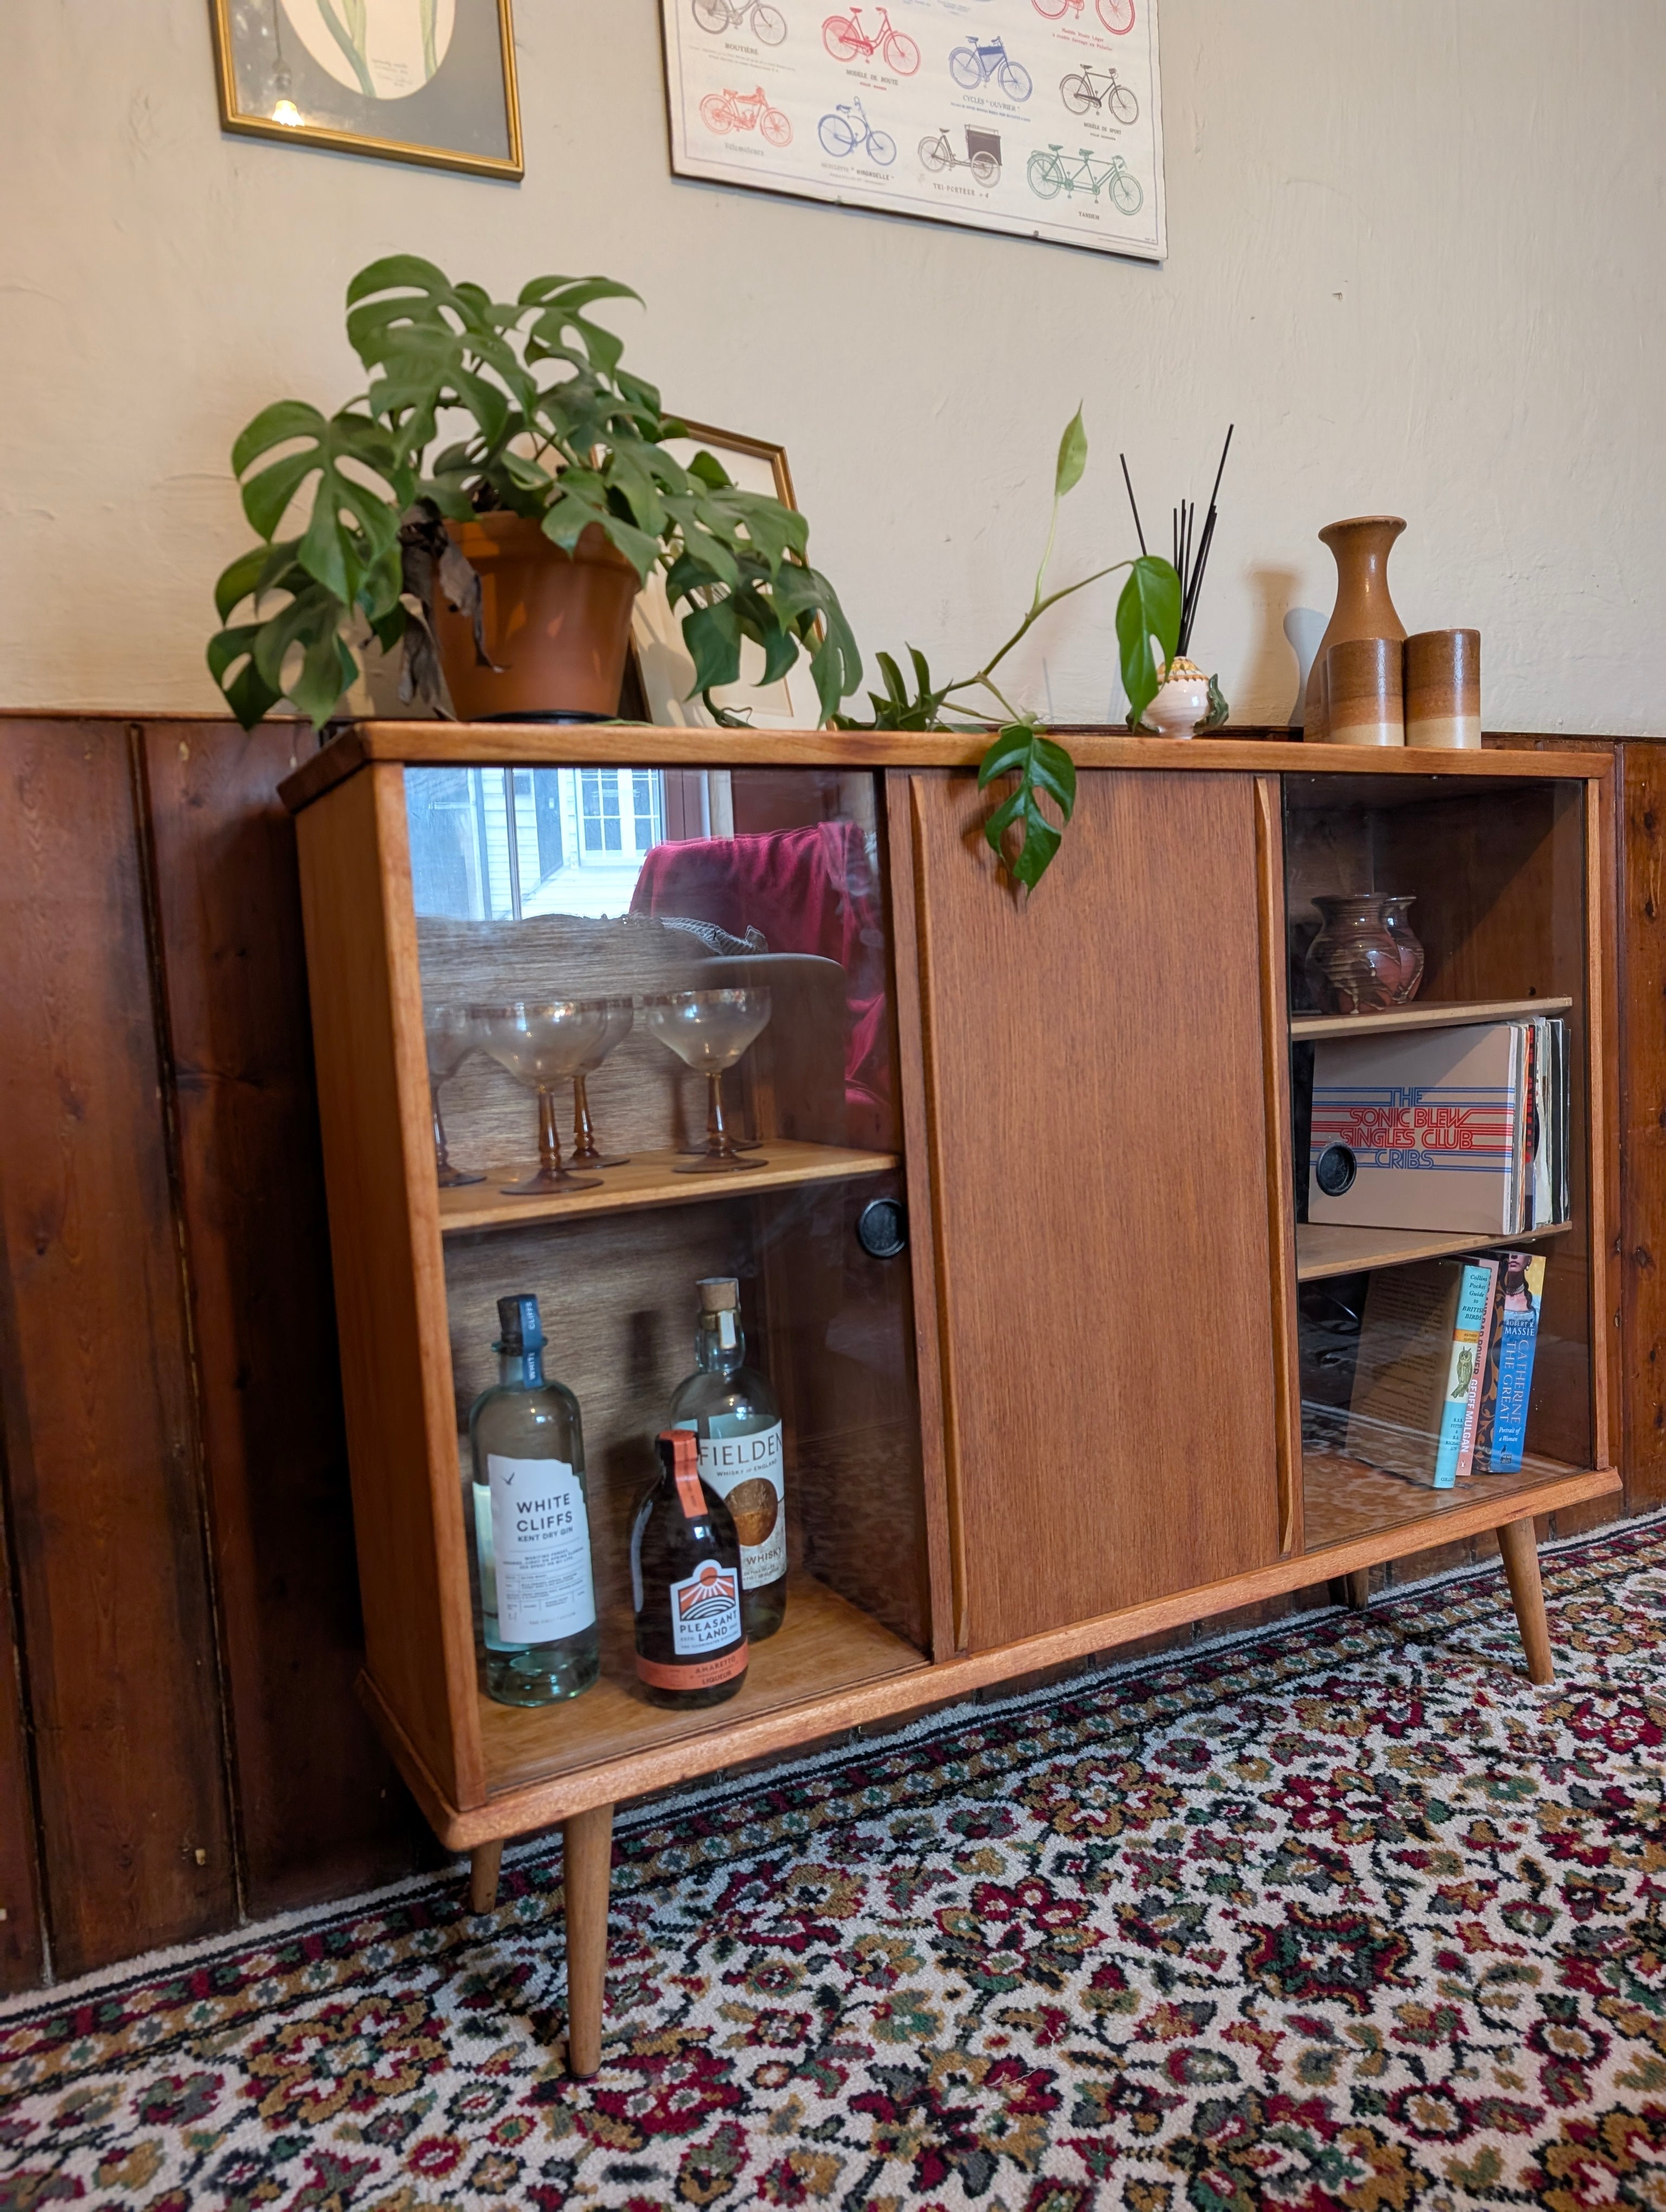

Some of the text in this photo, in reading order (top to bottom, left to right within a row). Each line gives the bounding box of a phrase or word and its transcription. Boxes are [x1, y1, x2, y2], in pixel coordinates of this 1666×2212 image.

[725, 43, 759, 54] ROUTIÈRE
[963, 95, 985, 105] CYCLES
[933, 183, 975, 196] TRI-PORTEUR
[1078, 211, 1100, 220] TANDEM
[1390, 1087, 1422, 1107] THE
[1350, 1108, 1465, 1129] SONIC BLEW
[1340, 1127, 1473, 1149] SINGLES CLUB
[1375, 1149, 1434, 1169] CRIBS
[525, 1301, 536, 1330] CLIFFS
[1504, 1327, 1535, 1336] MASSIE
[1473, 1339, 1483, 1375] POWER
[1499, 1341, 1517, 1423] THE GREAT
[1511, 1340, 1529, 1424] CATHERINE
[1461, 1379, 1478, 1453] GEOFF MULGAN
[1515, 1427, 1522, 1436] of
[699, 1432, 782, 1466] FIELDEN
[754, 1458, 777, 1471] ENGLAND
[516, 1493, 571, 1514] WHITE
[517, 1510, 573, 1533] CLIFFS
[517, 1526, 573, 1542] KENT DRY GIN
[680, 1610, 737, 1633] PLEASANT
[699, 1626, 728, 1642] LAND
[695, 1655, 736, 1674] AMARETTO
[702, 1670, 732, 1685] LIQUEUR
